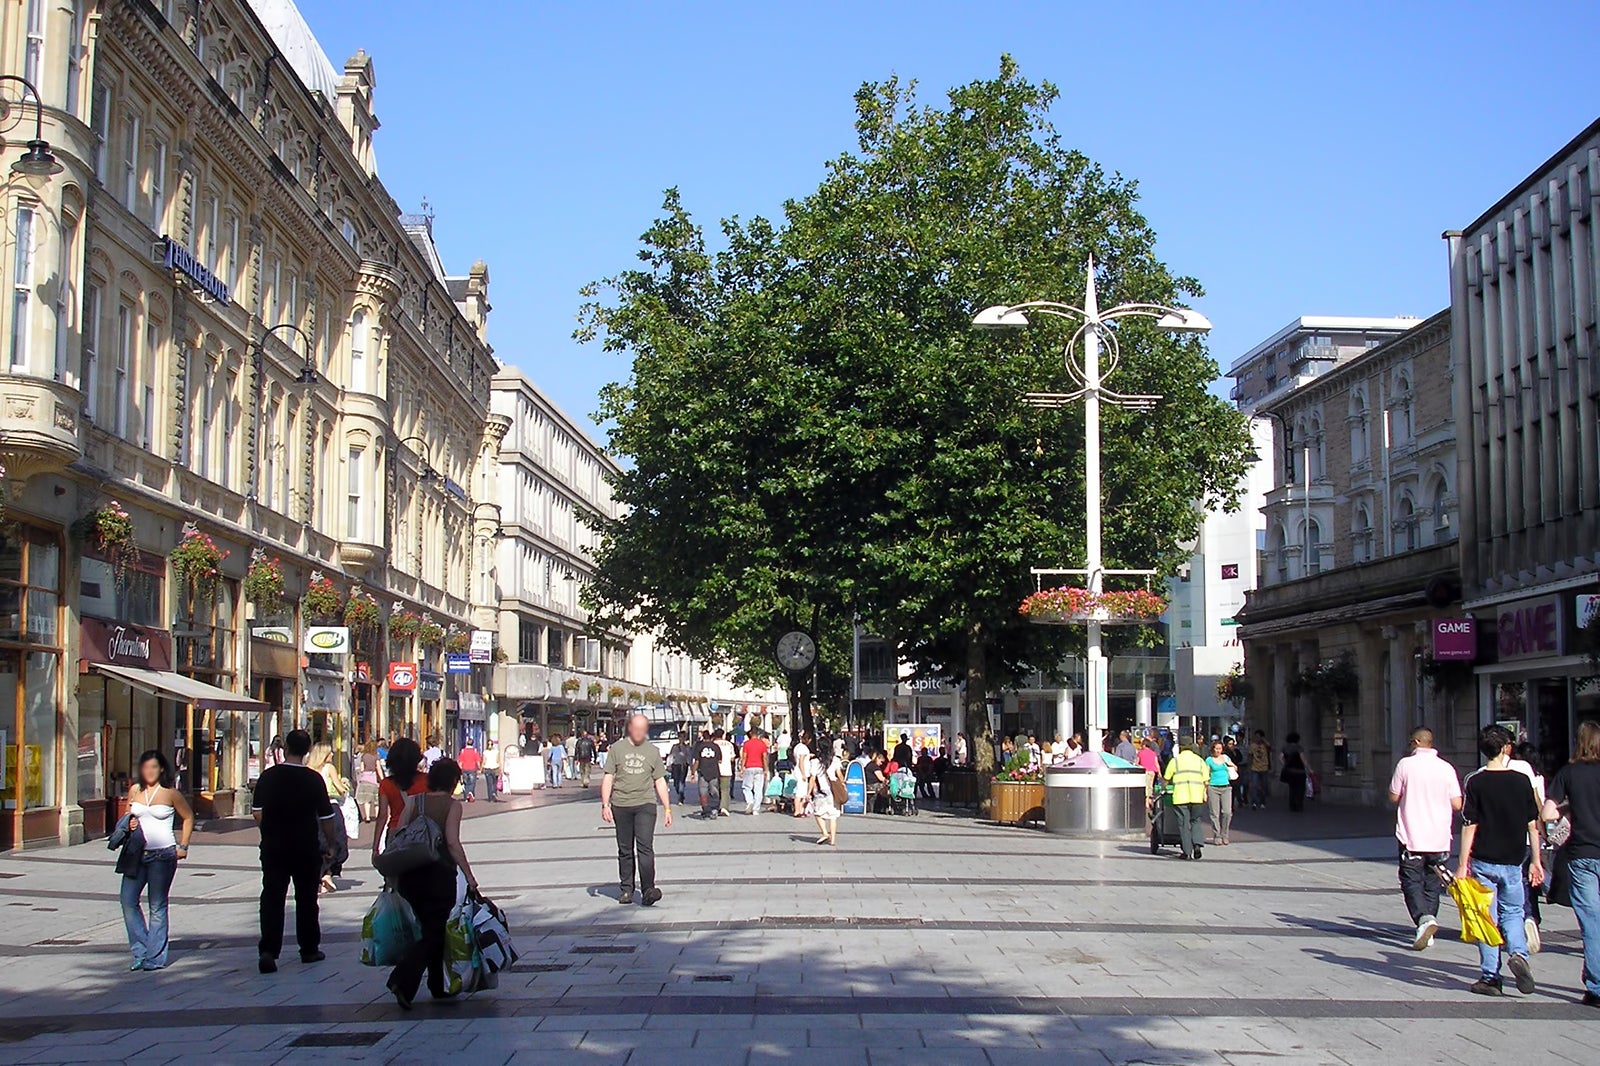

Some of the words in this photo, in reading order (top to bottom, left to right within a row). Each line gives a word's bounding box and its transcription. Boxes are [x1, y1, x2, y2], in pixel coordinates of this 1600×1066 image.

[109, 626, 150, 659] Thorntons
[1438, 623, 1470, 633] GAME
[1499, 604, 1556, 656] GAME
